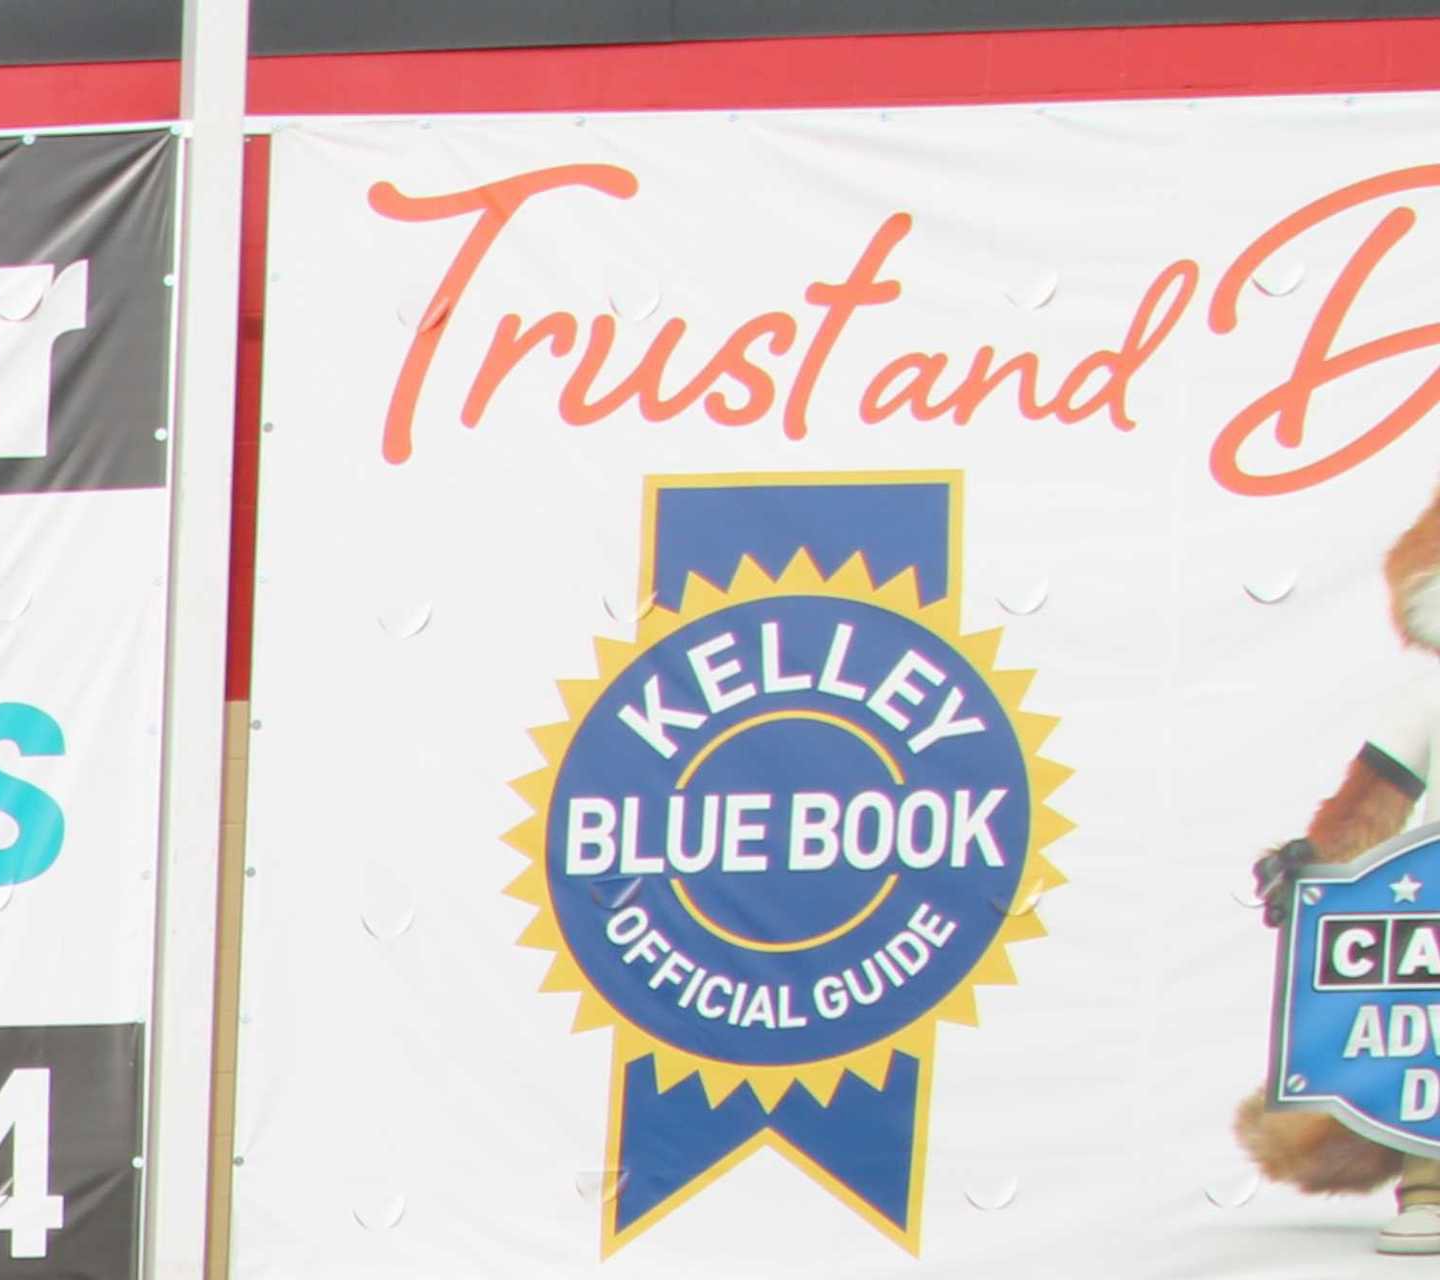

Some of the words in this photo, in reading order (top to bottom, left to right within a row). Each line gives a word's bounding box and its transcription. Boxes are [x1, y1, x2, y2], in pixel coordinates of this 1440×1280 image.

[367, 162, 913, 466] Trust
[858, 257, 1200, 432] and
[616, 620, 986, 758] KELLEY
[565, 793, 771, 876] BLUE
[788, 788, 1008, 872] BOOK
[604, 902, 810, 1031] OFFICIAL
[813, 902, 958, 1020] GUIDE
